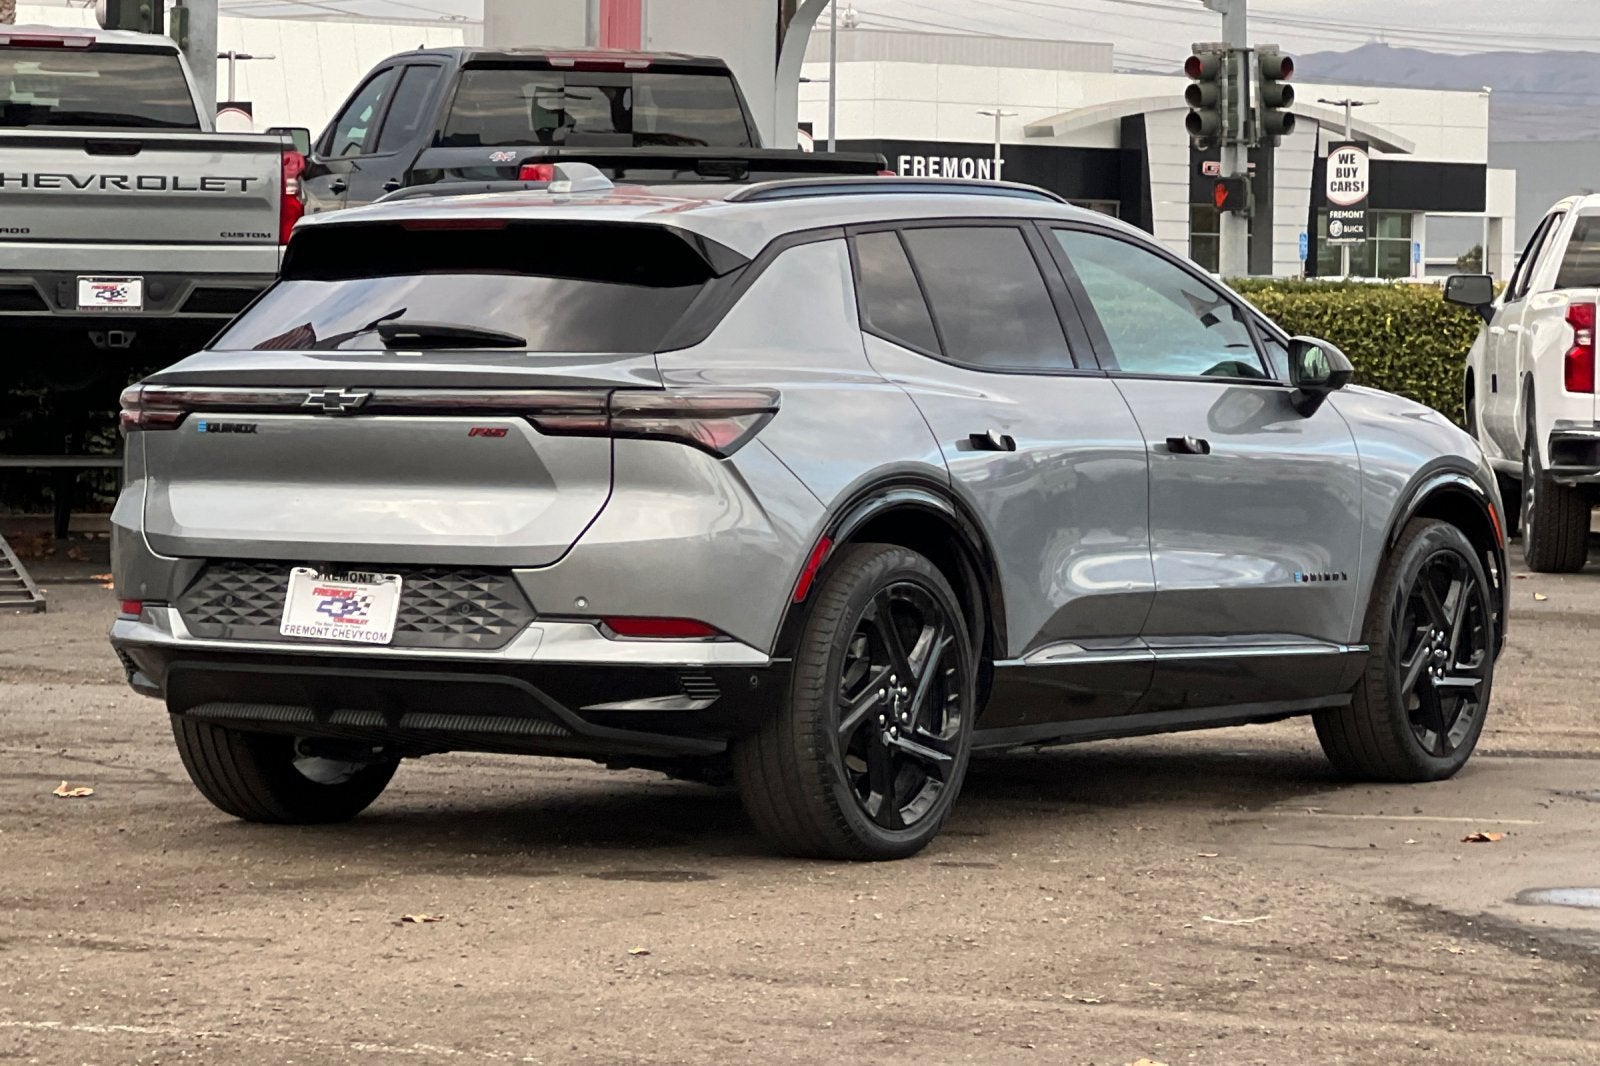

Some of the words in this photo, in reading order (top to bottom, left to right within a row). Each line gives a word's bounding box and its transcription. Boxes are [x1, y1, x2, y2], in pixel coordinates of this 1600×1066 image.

[1338, 153, 1356, 165] WE
[1336, 167, 1358, 179] BUY
[0, 173, 258, 192] HEVROLET
[1330, 181, 1365, 193] CARS!
[1329, 211, 1364, 219] FREMONT
[1343, 224, 1364, 233] BUICK
[220, 231, 272, 239] CUSTOM
[198, 420, 258, 434] EQUINOX
[468, 427, 509, 438] RS
[284, 624, 329, 638] FREMONT
